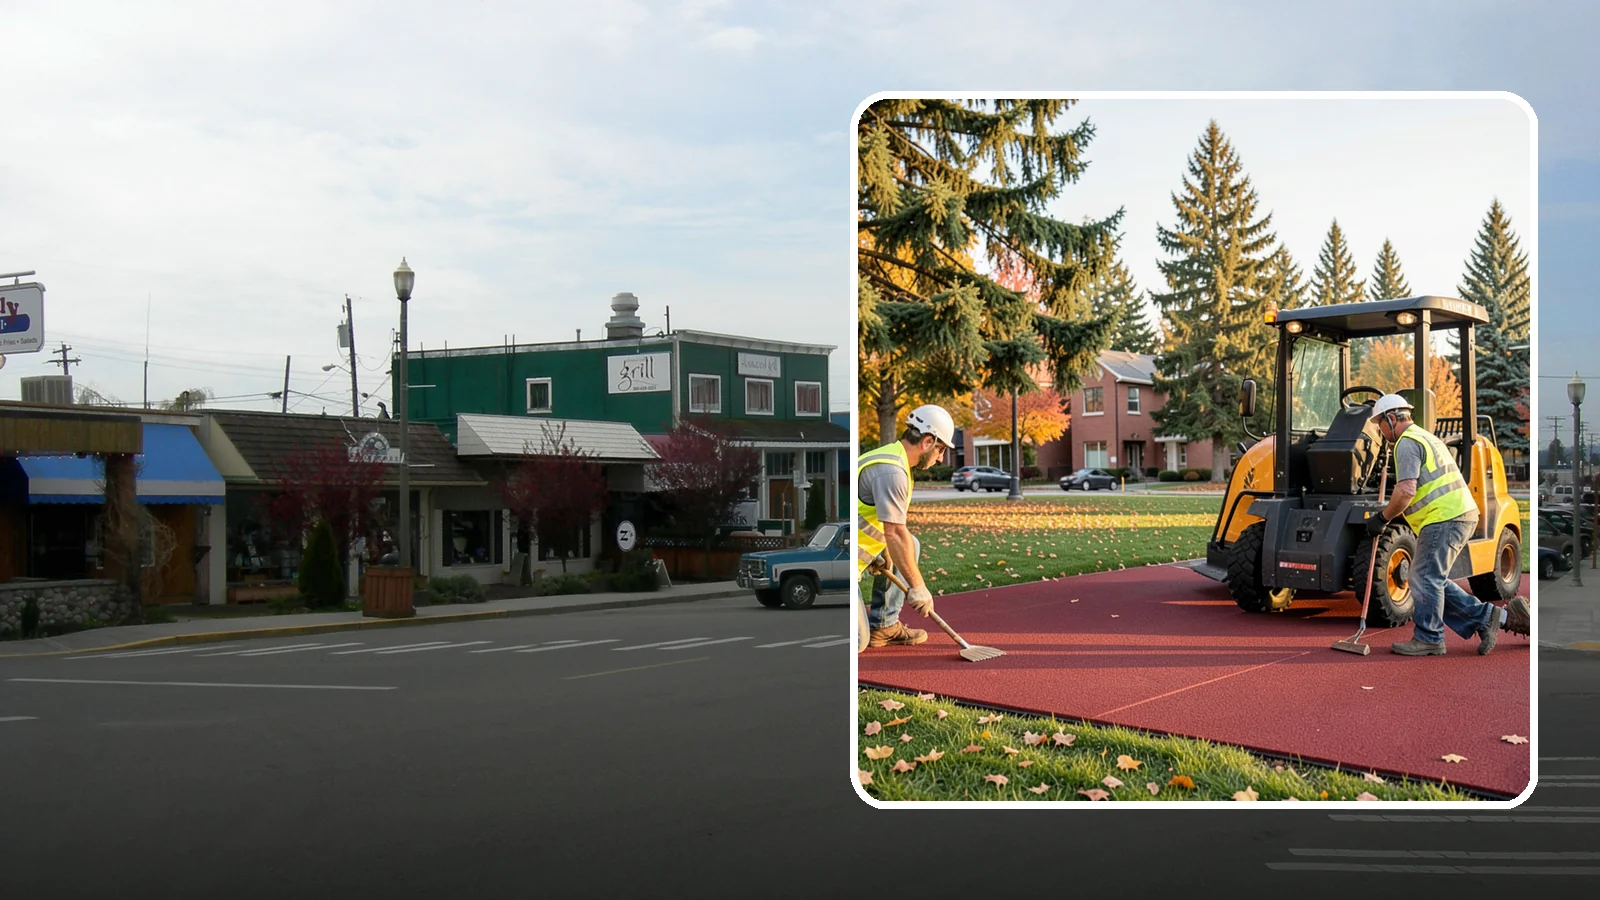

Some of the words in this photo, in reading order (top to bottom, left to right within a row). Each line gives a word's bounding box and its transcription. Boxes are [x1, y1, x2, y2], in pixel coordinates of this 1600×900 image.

[4, 338, 16, 346] Fries
[21, 337, 38, 345] Salads
[618, 356, 655, 391] grill
